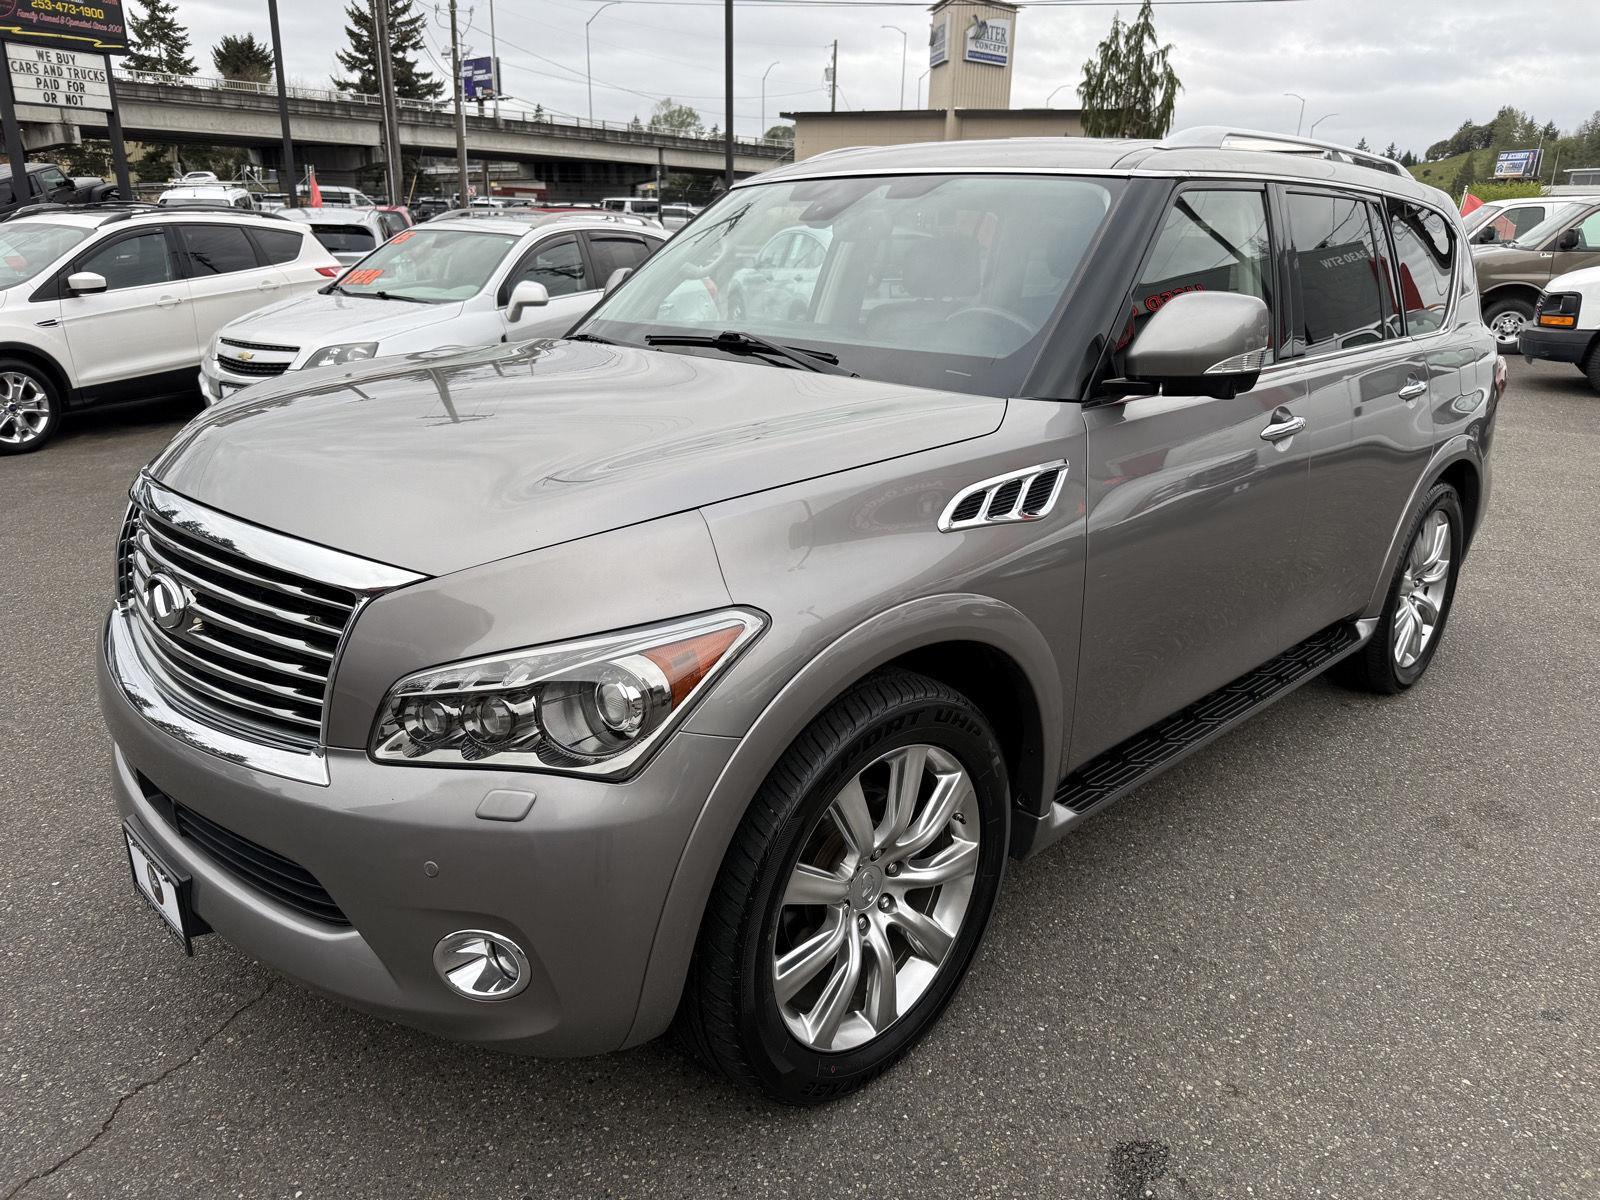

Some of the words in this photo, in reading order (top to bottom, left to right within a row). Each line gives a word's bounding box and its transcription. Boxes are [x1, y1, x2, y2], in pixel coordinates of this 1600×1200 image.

[31, 0, 104, 18] 253-473-1900
[975, 41, 1008, 54] CONCEPTS
[36, 50, 51, 62] WE
[56, 52, 76, 65] BUY
[11, 61, 39, 74] CARS
[43, 65, 63, 77] AND
[67, 67, 106, 82] TRUCKS
[36, 77, 60, 90] PAID
[67, 80, 86, 93] FOR
[43, 92, 58, 104] OR
[65, 95, 84, 106] NOT
